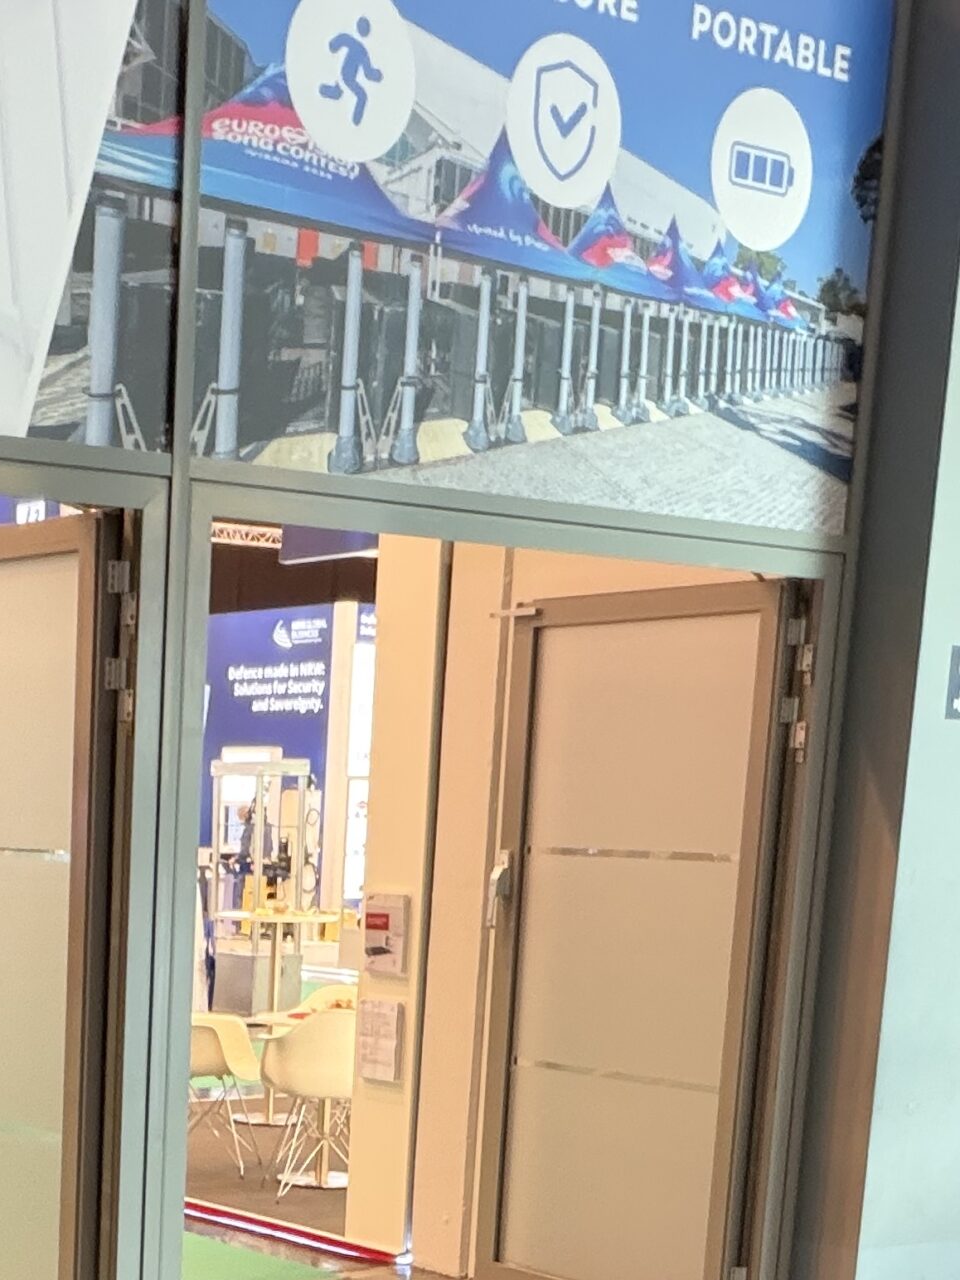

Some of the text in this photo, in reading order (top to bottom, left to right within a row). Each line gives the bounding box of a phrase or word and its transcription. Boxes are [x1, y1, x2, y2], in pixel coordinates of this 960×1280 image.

[691, 3, 853, 83] PORTABLE
[228, 664, 263, 681] Defence
[263, 663, 289, 679] made
[289, 662, 299, 677] in
[233, 678, 326, 697] Solutions for Security
[251, 697, 270, 713] and
